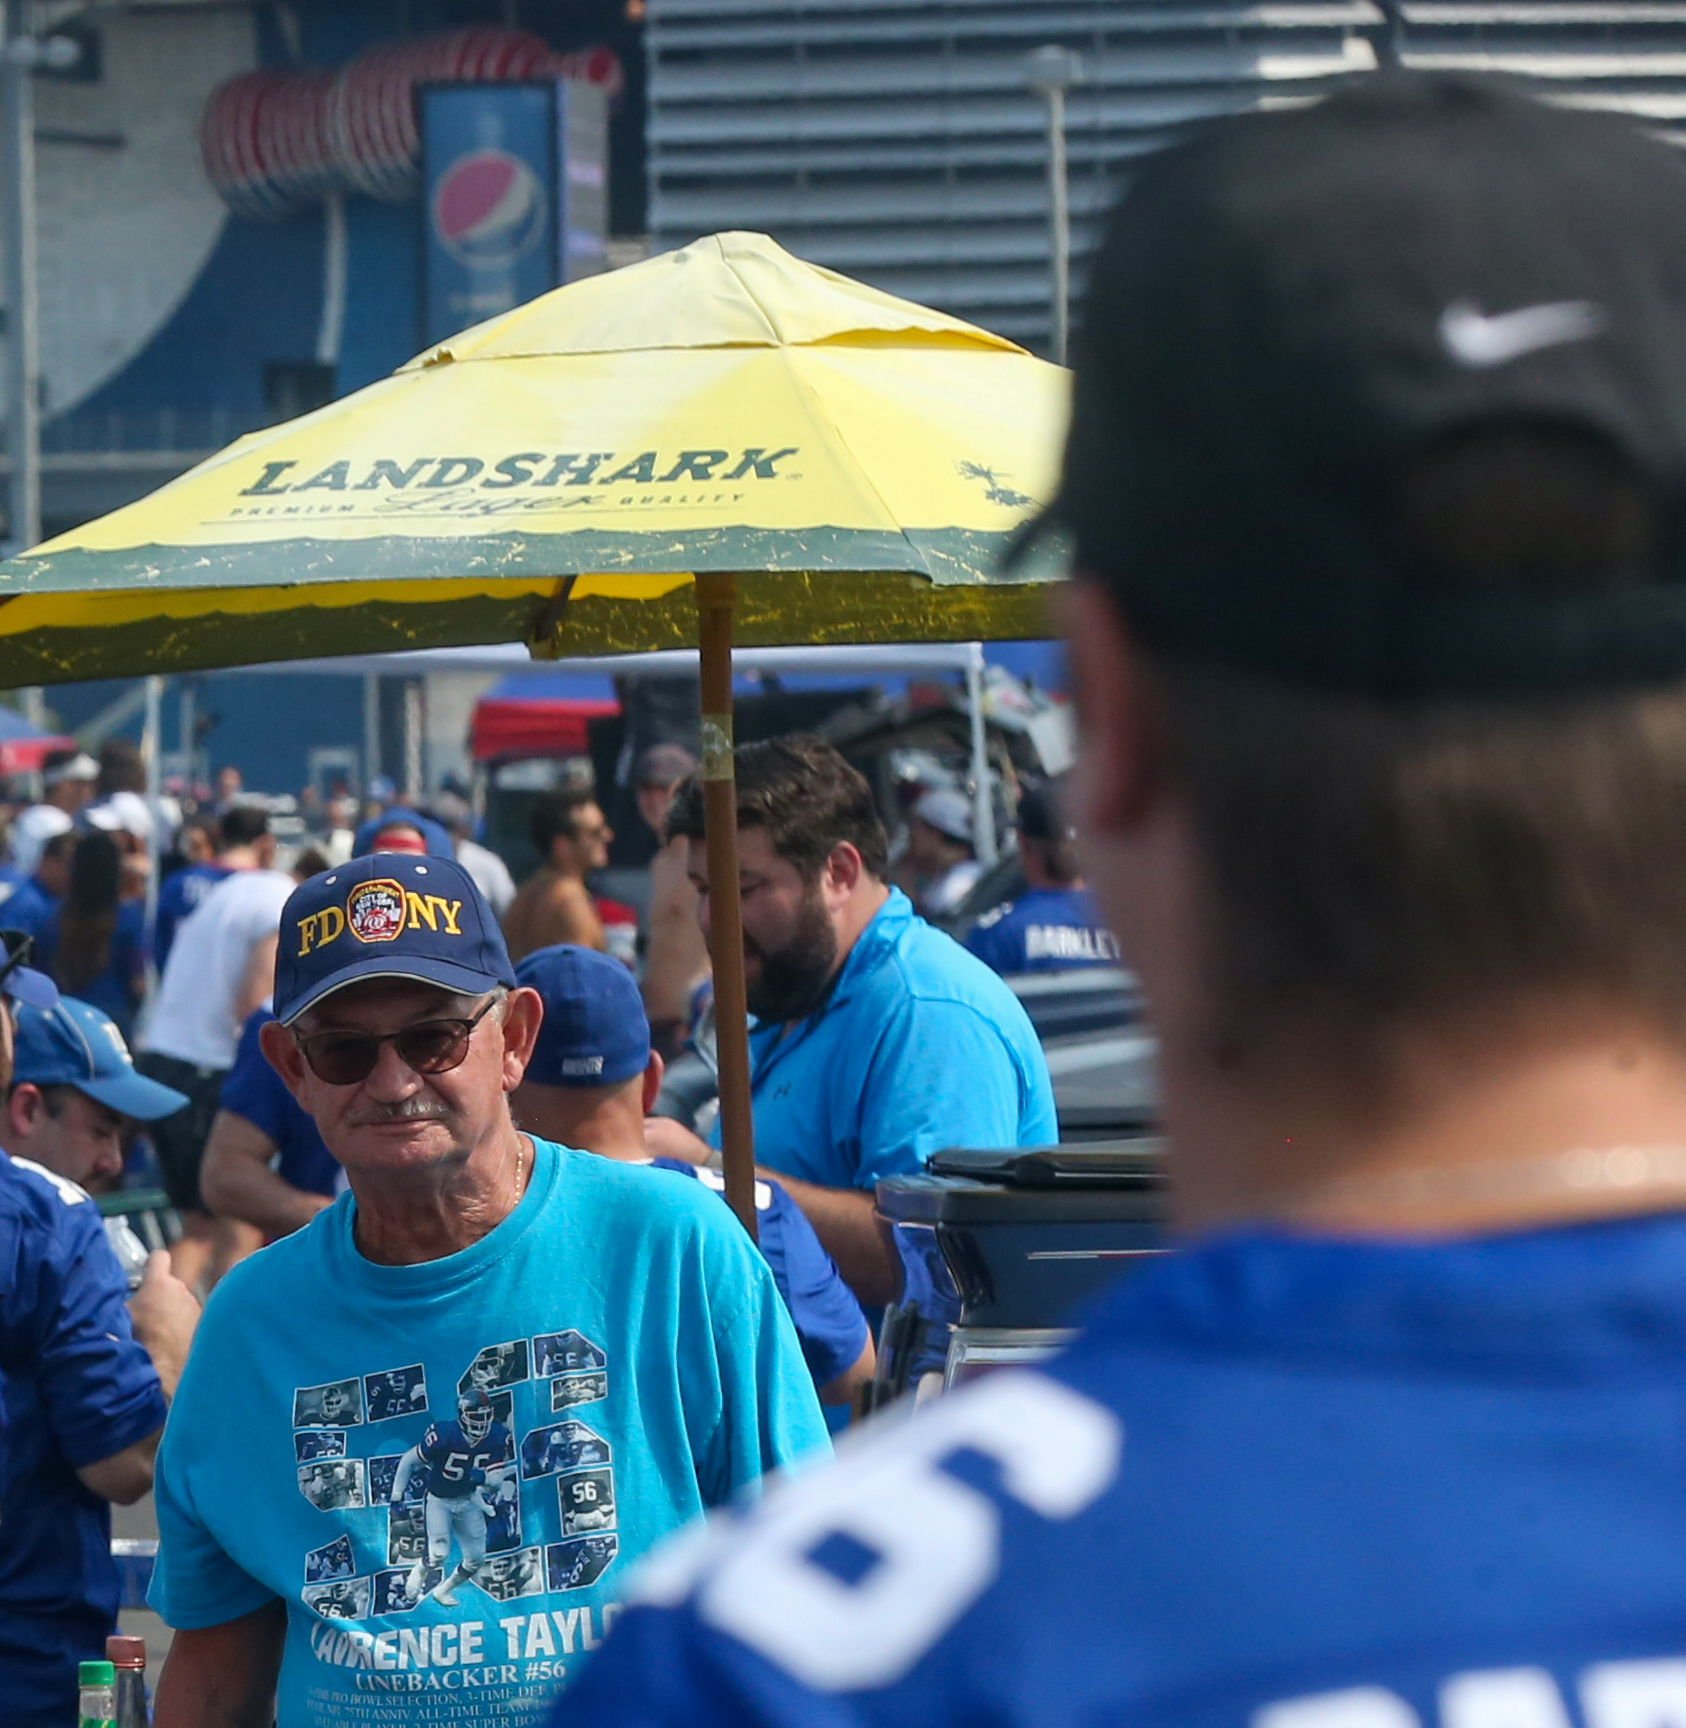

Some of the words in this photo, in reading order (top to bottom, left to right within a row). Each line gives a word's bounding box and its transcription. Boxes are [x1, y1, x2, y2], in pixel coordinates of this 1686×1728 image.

[238, 447, 800, 496] LANDSHARK
[572, 1481, 598, 1504] 56
[399, 1536, 426, 1552] 56
[356, 1664, 520, 1693] LINEBACKER
[525, 1660, 566, 1681] #56
[416, 1705, 484, 1720] ALL-TIME
